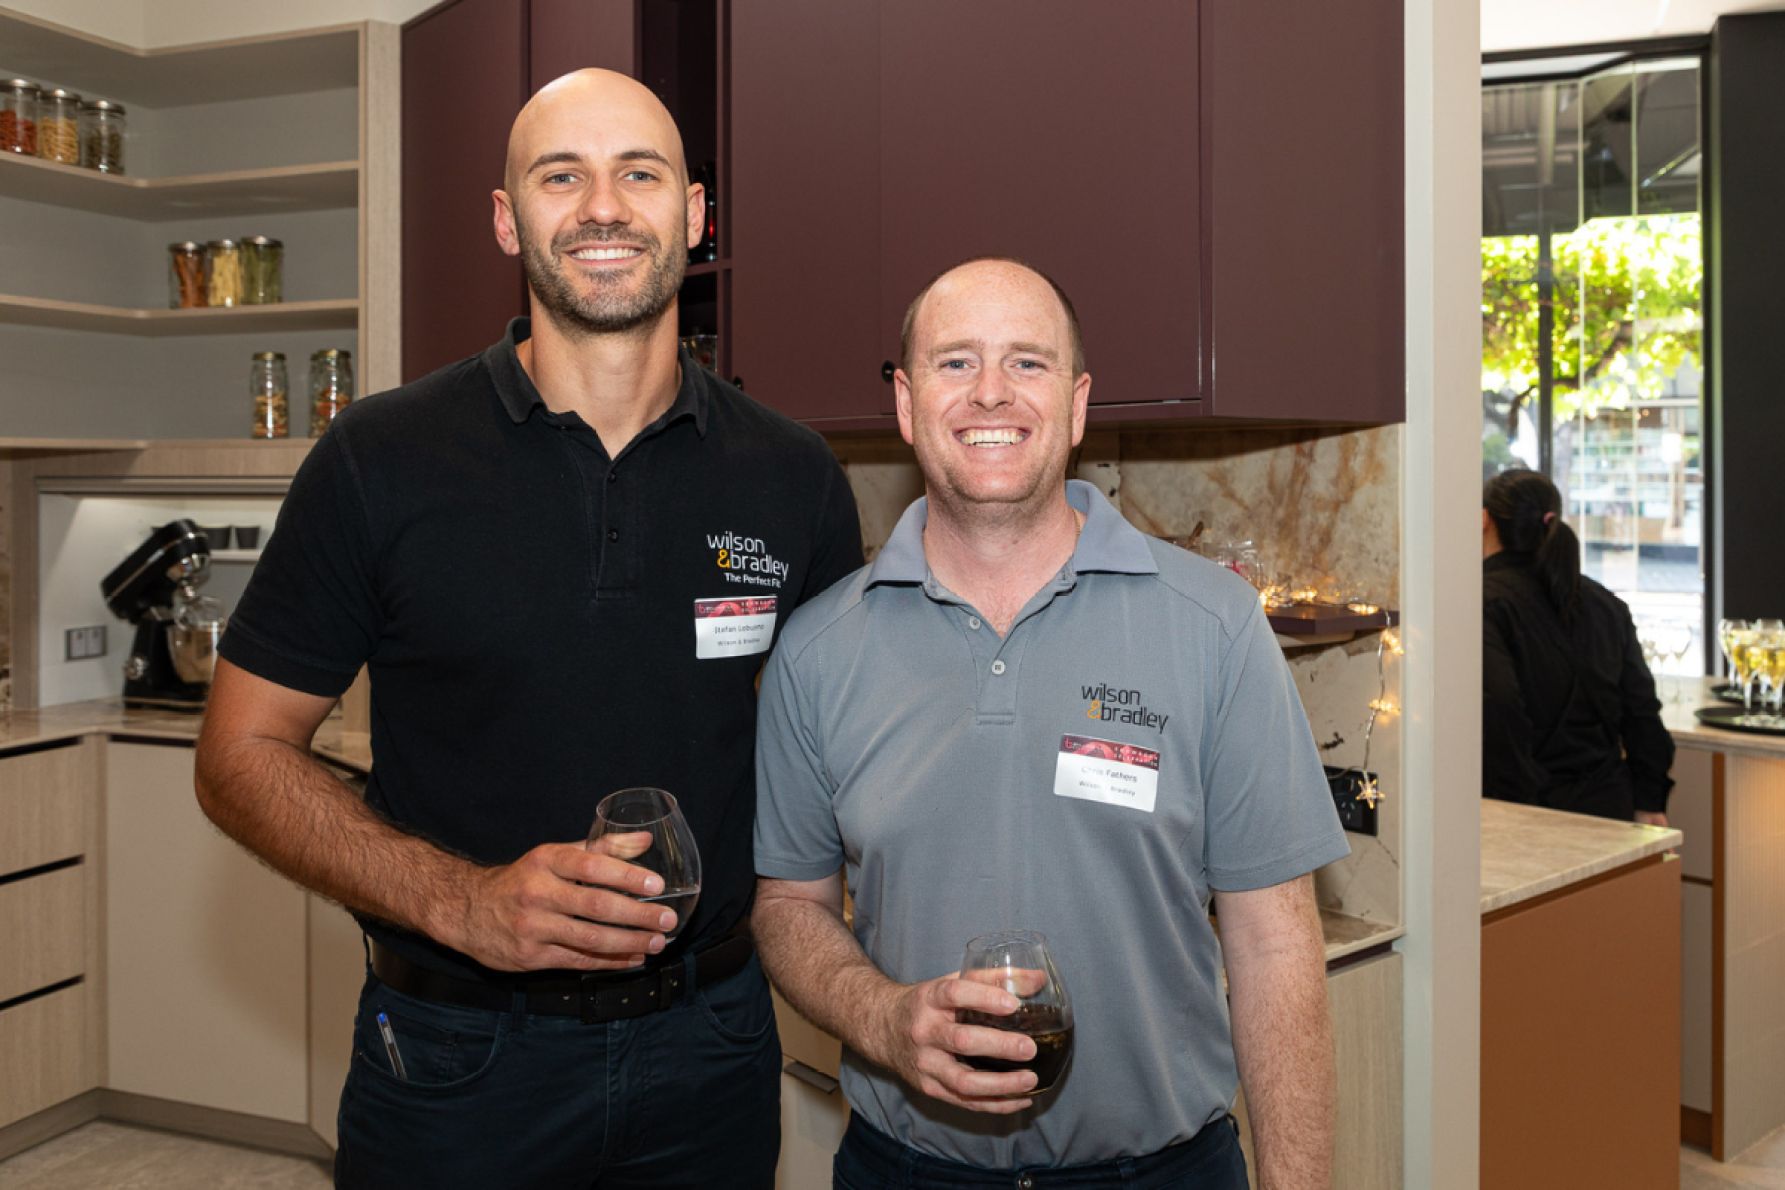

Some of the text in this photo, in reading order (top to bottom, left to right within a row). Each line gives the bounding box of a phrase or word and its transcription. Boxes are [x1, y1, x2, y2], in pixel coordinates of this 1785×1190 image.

[706, 530, 766, 554] wilson
[716, 548, 790, 582] &bradley
[723, 572, 782, 589] The Perfect Fit
[1081, 682, 1141, 706] wilson
[1086, 698, 1169, 735] &bradley
[1106, 769, 1138, 783] Fathers
